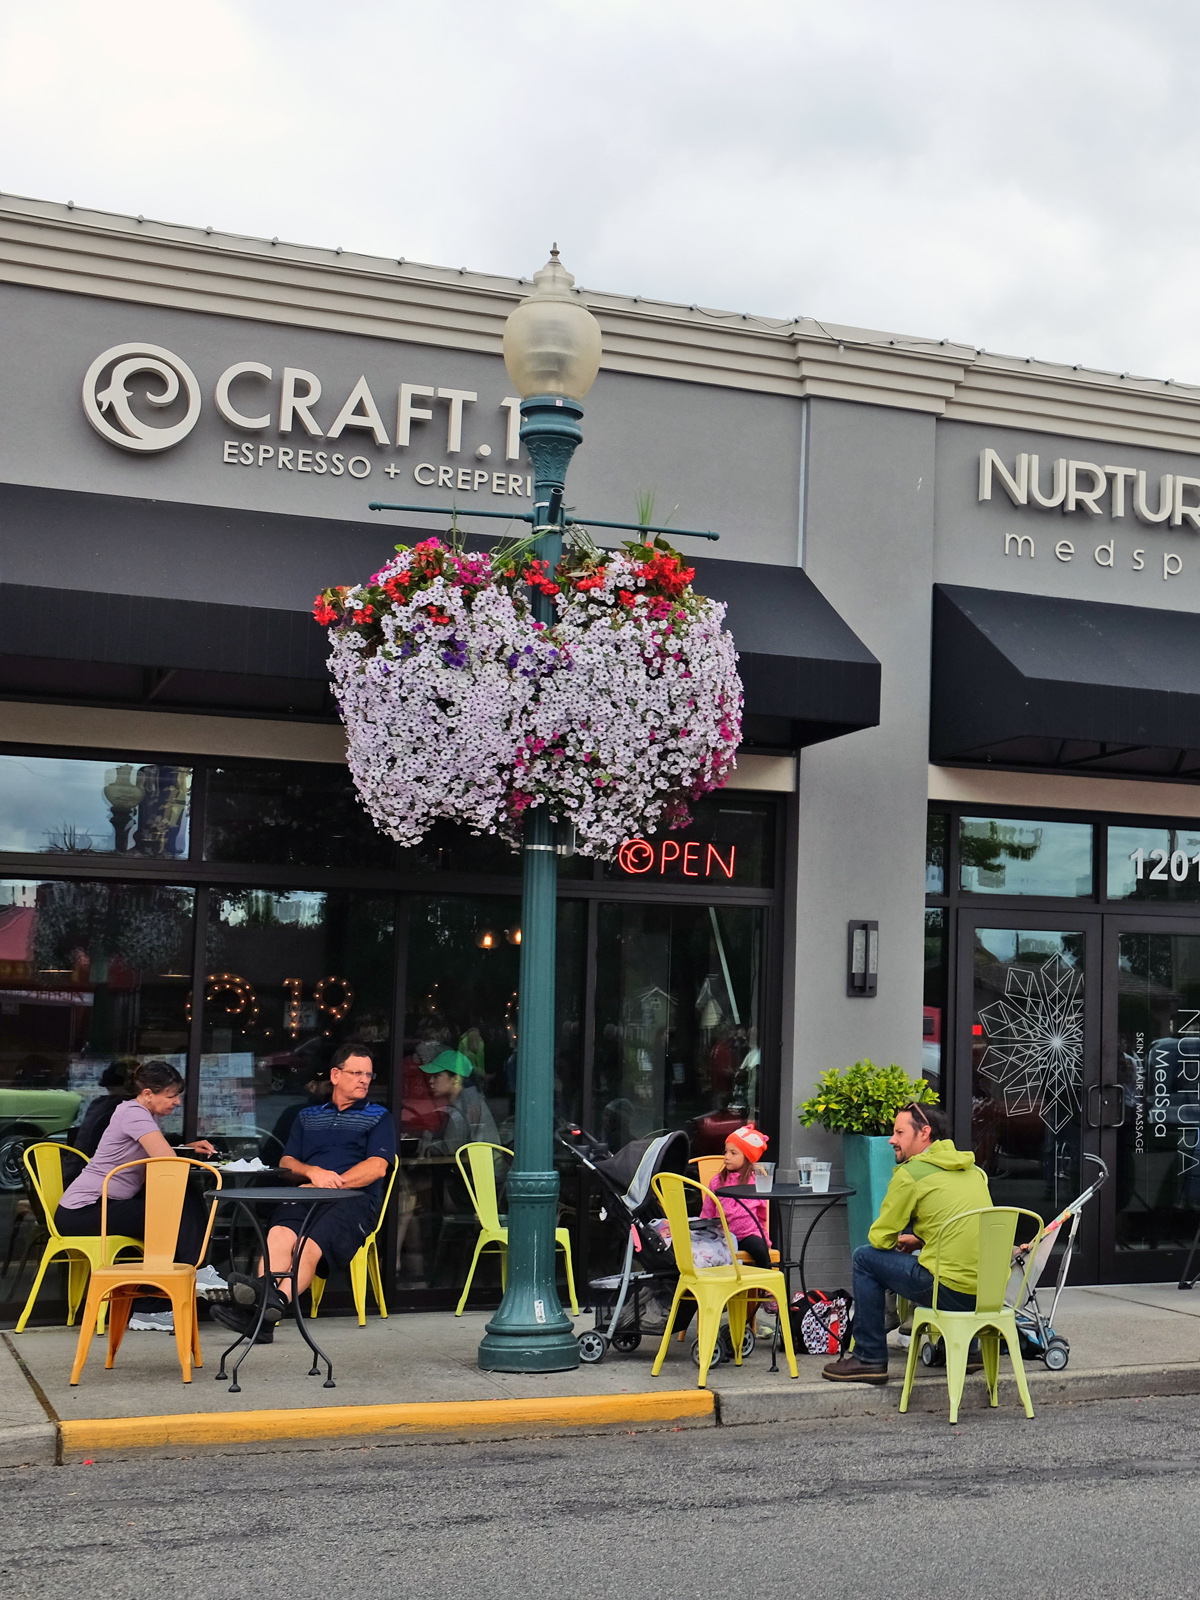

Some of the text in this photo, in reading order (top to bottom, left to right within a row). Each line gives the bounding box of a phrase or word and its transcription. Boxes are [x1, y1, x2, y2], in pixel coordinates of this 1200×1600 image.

[214, 360, 523, 462] CRAFT.1
[222, 439, 372, 479] ESPRESSO
[413, 463, 532, 497] CREPERI
[618, 838, 735, 878] OPEN
[1135, 1031, 1145, 1055] SKIN
[1135, 1066, 1144, 1090] HAIR
[1151, 1049, 1171, 1138] MedSpa
[1176, 1009, 1200, 1176] NURTURA
[1135, 1102, 1145, 1154] MASSAGE
